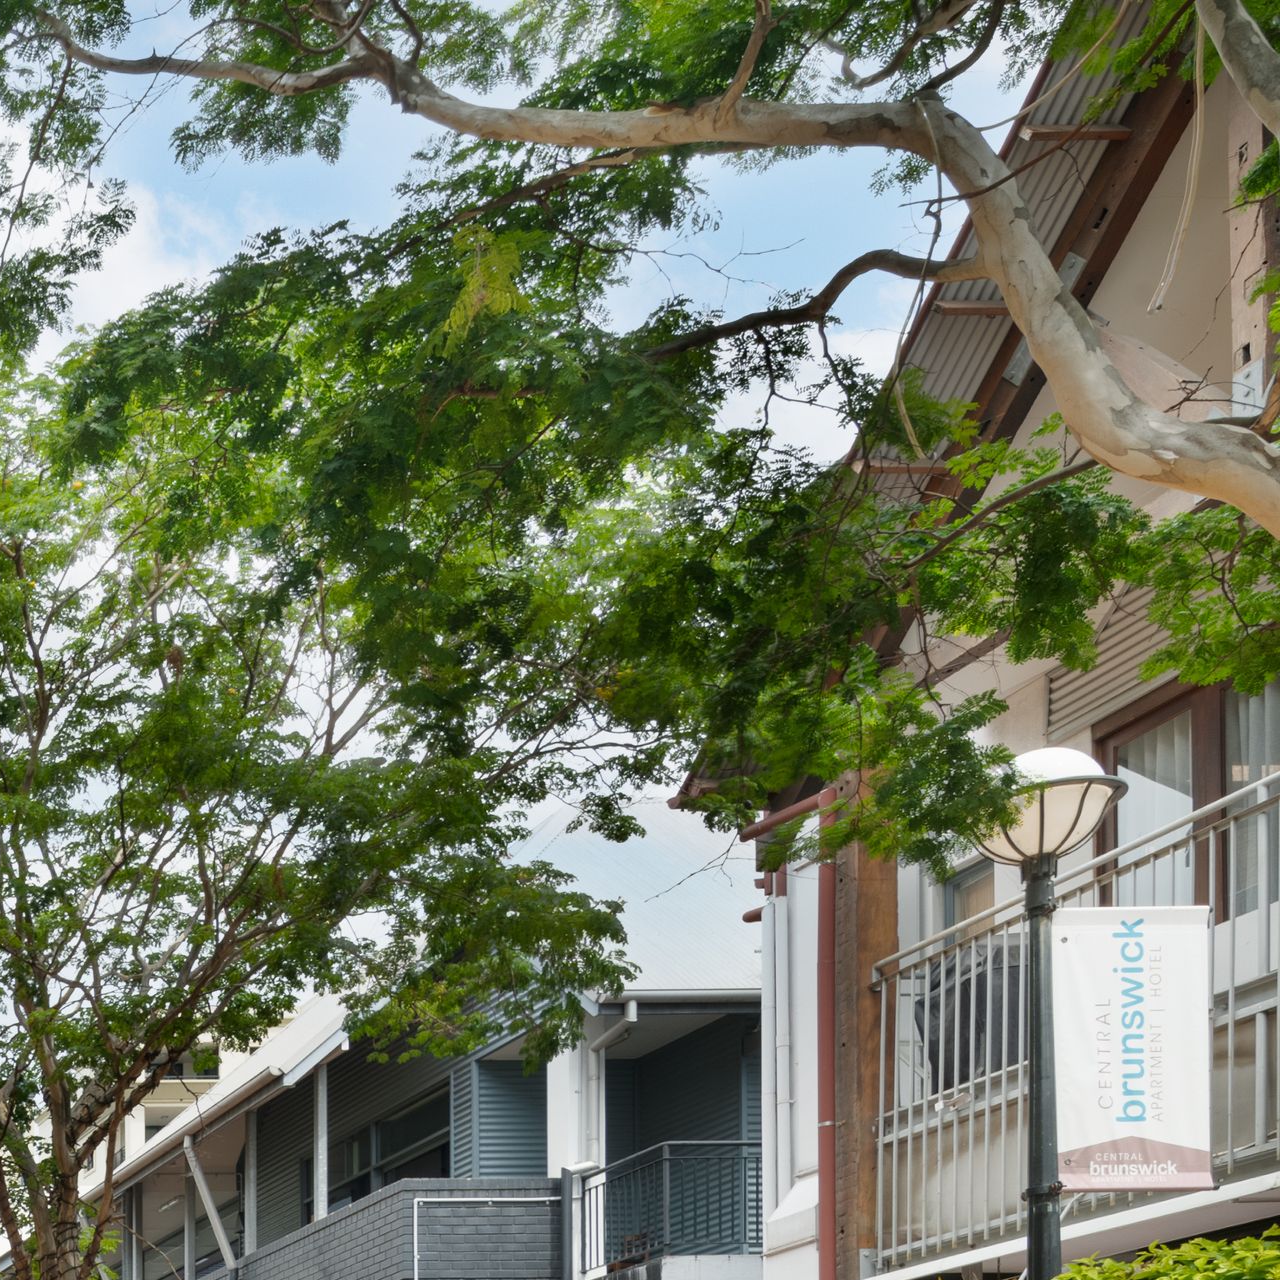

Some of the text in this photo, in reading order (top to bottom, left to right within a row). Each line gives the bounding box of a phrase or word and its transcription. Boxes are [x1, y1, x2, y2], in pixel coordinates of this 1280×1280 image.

[1095, 998, 1113, 1110] CENTRAL
[1112, 918, 1147, 1122] brunswick
[1149, 945, 1164, 1122] APARTMENT HOTEL
[1089, 1160, 1178, 1176] brunswick
[1095, 1152, 1143, 1161] CENTRAL
